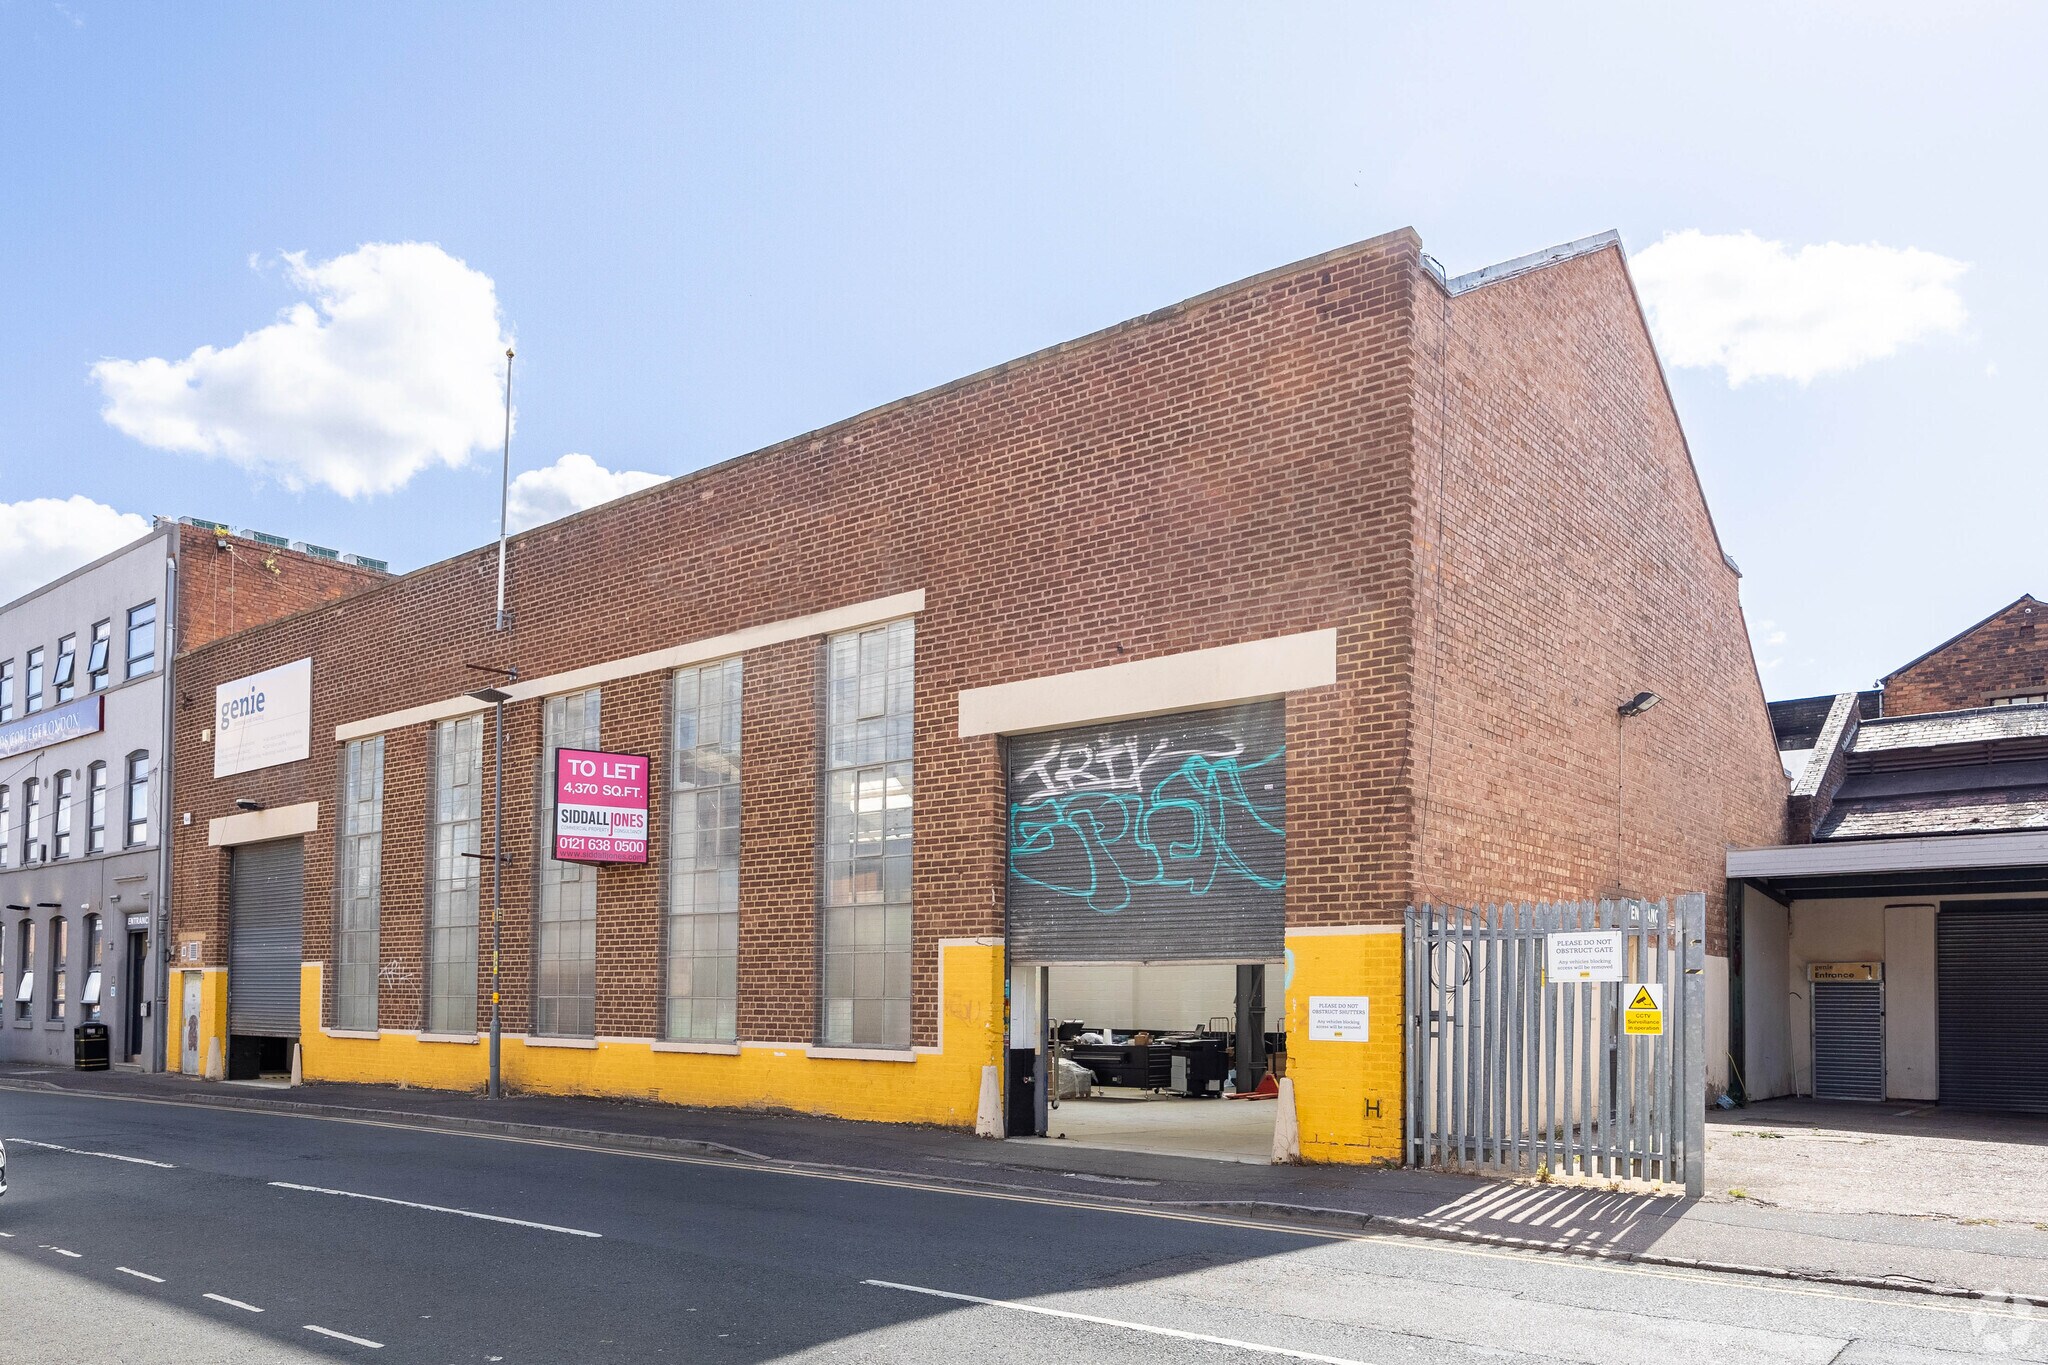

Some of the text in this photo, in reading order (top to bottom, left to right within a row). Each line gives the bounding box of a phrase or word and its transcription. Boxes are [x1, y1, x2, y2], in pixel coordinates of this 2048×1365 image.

[220, 685, 266, 731] genie
[42, 713, 79, 736] LONDON
[567, 759, 641, 780] TO LET
[563, 782, 643, 799] 4,370 SQ.FT.
[560, 824, 587, 832] COMMERCIAL
[559, 837, 644, 853] 0121 638 0500
[560, 851, 644, 861] www.siddalljones.com
